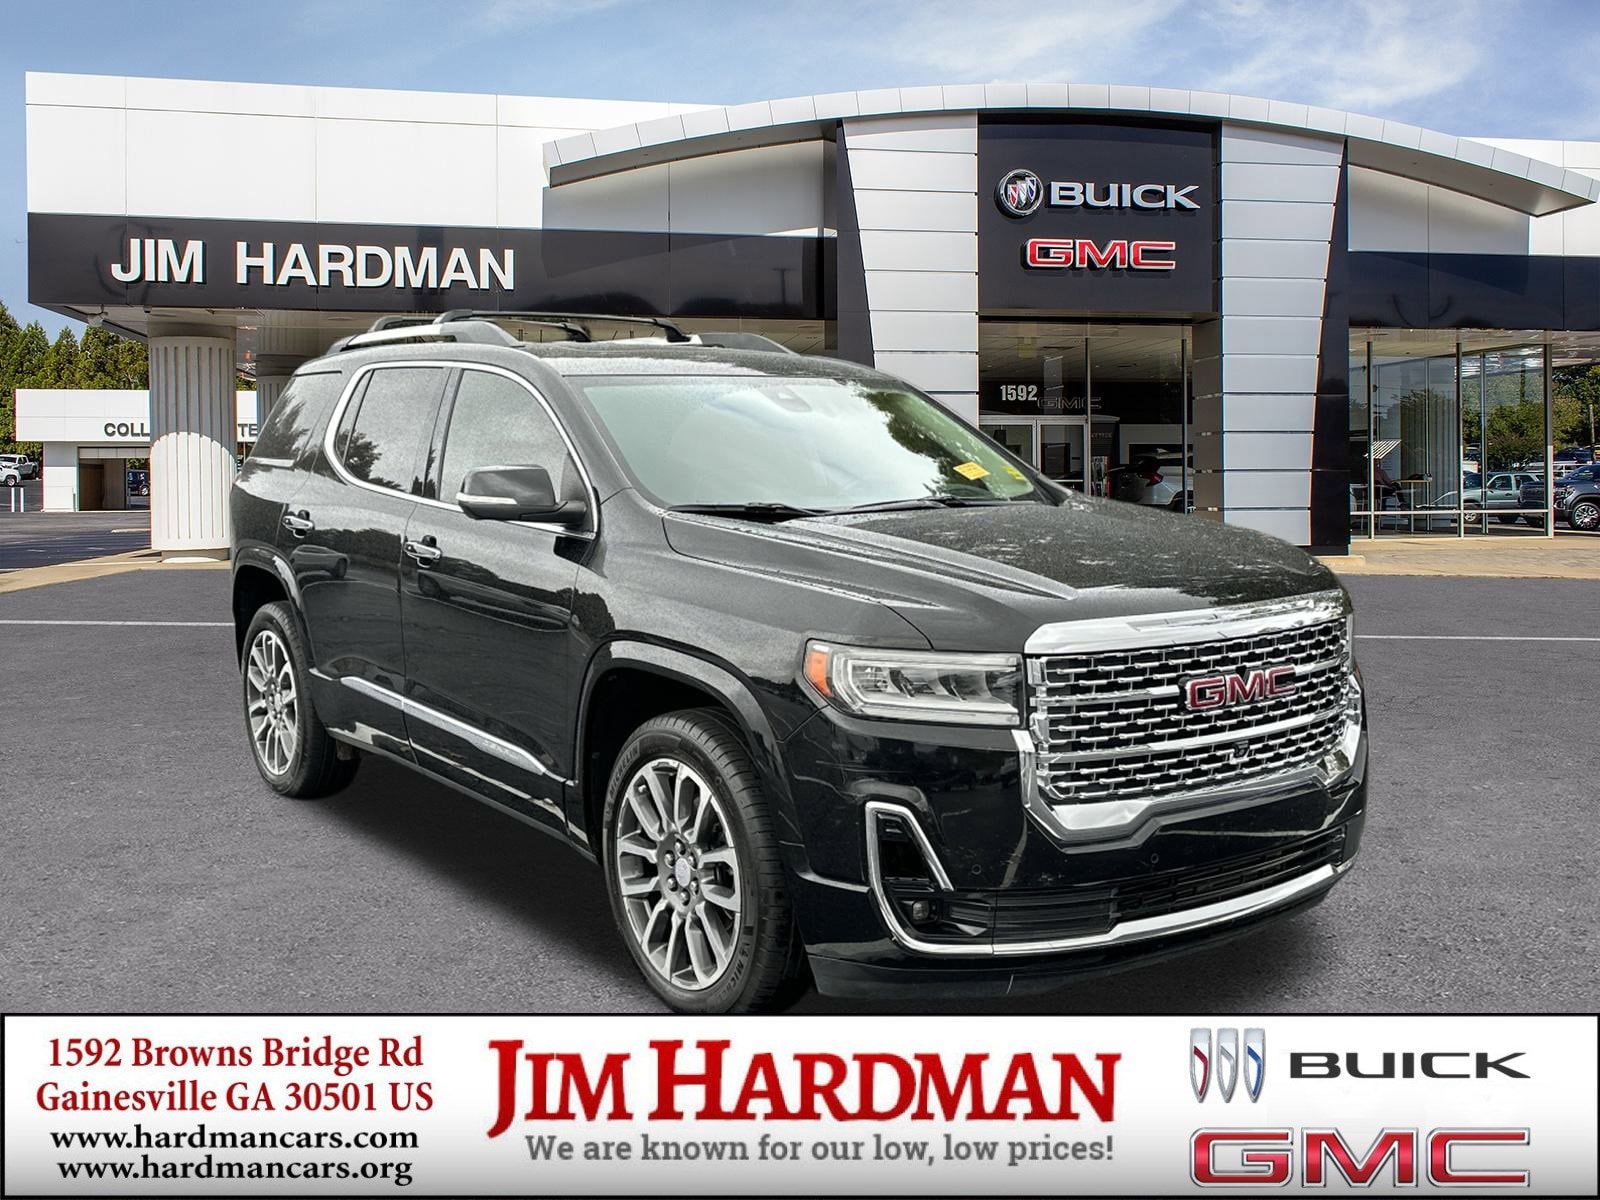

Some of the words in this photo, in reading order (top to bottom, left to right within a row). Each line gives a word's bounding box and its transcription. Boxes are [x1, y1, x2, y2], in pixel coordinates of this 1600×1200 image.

[1051, 181, 1200, 209] BUICK
[111, 238, 203, 283] JIM
[236, 241, 514, 290] HARDMAN
[1027, 238, 1176, 270] GMC
[1000, 384, 1037, 401] 1592
[1037, 396, 1102, 409] GMC
[104, 422, 150, 437] COLL
[237, 423, 258, 436] TE
[1186, 664, 1296, 710] GMC
